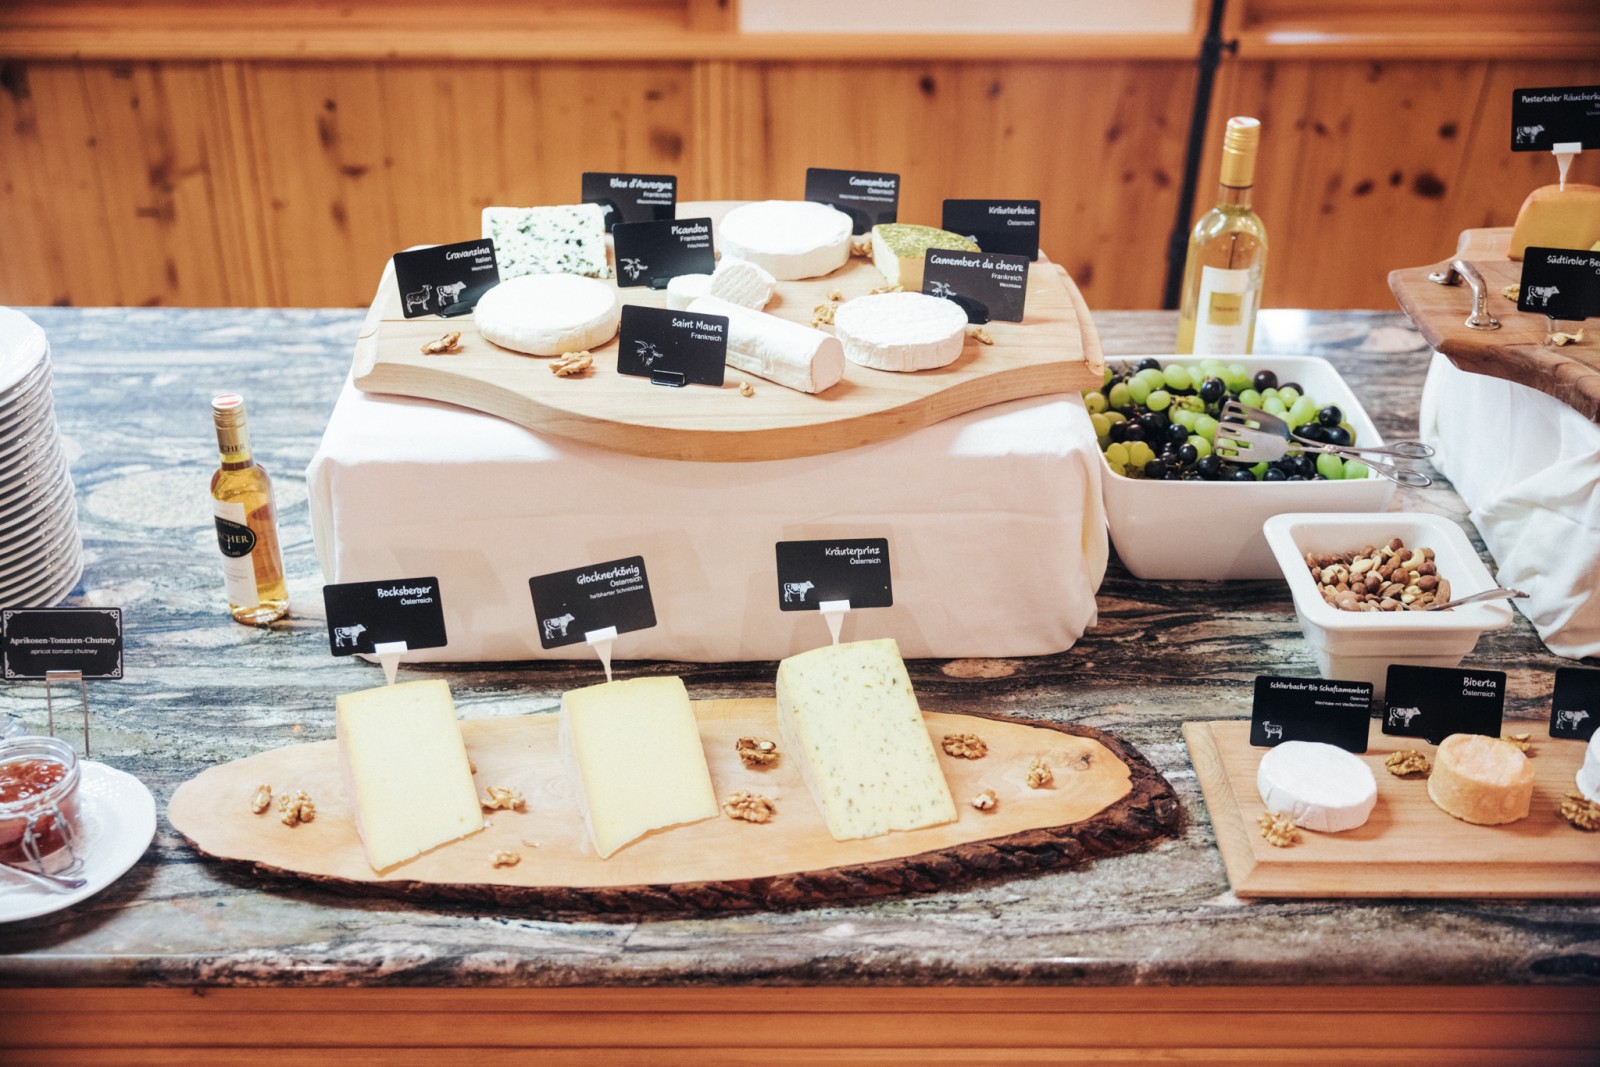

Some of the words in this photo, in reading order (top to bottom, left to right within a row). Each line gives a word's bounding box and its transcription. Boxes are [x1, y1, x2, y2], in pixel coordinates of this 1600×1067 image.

[849, 176, 896, 189] Camembert
[988, 205, 1036, 215] Kräuterkäse
[671, 223, 708, 235] Picandou
[680, 234, 709, 242] Frankreich
[445, 246, 491, 261] Cravanzina
[475, 256, 492, 264] Italien
[930, 254, 980, 268] Camembert
[982, 259, 993, 269] du
[995, 260, 1024, 272] chevre
[1546, 254, 1588, 266] Südtiroler
[991, 272, 1023, 282] Frankreich
[672, 317, 694, 329] Saint
[695, 320, 723, 332] Maure
[690, 332, 722, 342] Frankreich
[825, 545, 881, 559] Kräuterprinz
[849, 557, 882, 565] Österreich
[576, 564, 640, 585] Glocknerkönig
[610, 575, 642, 587] Österreich
[377, 585, 432, 599] Bocksberger
[400, 597, 433, 605] Österreich
[9, 636, 116, 646] Aprikosen-Tomaten-Chutney
[1308, 684, 1318, 692] Bio
[1463, 676, 1496, 688] Bioerta
[1462, 689, 1496, 698] Österreich
